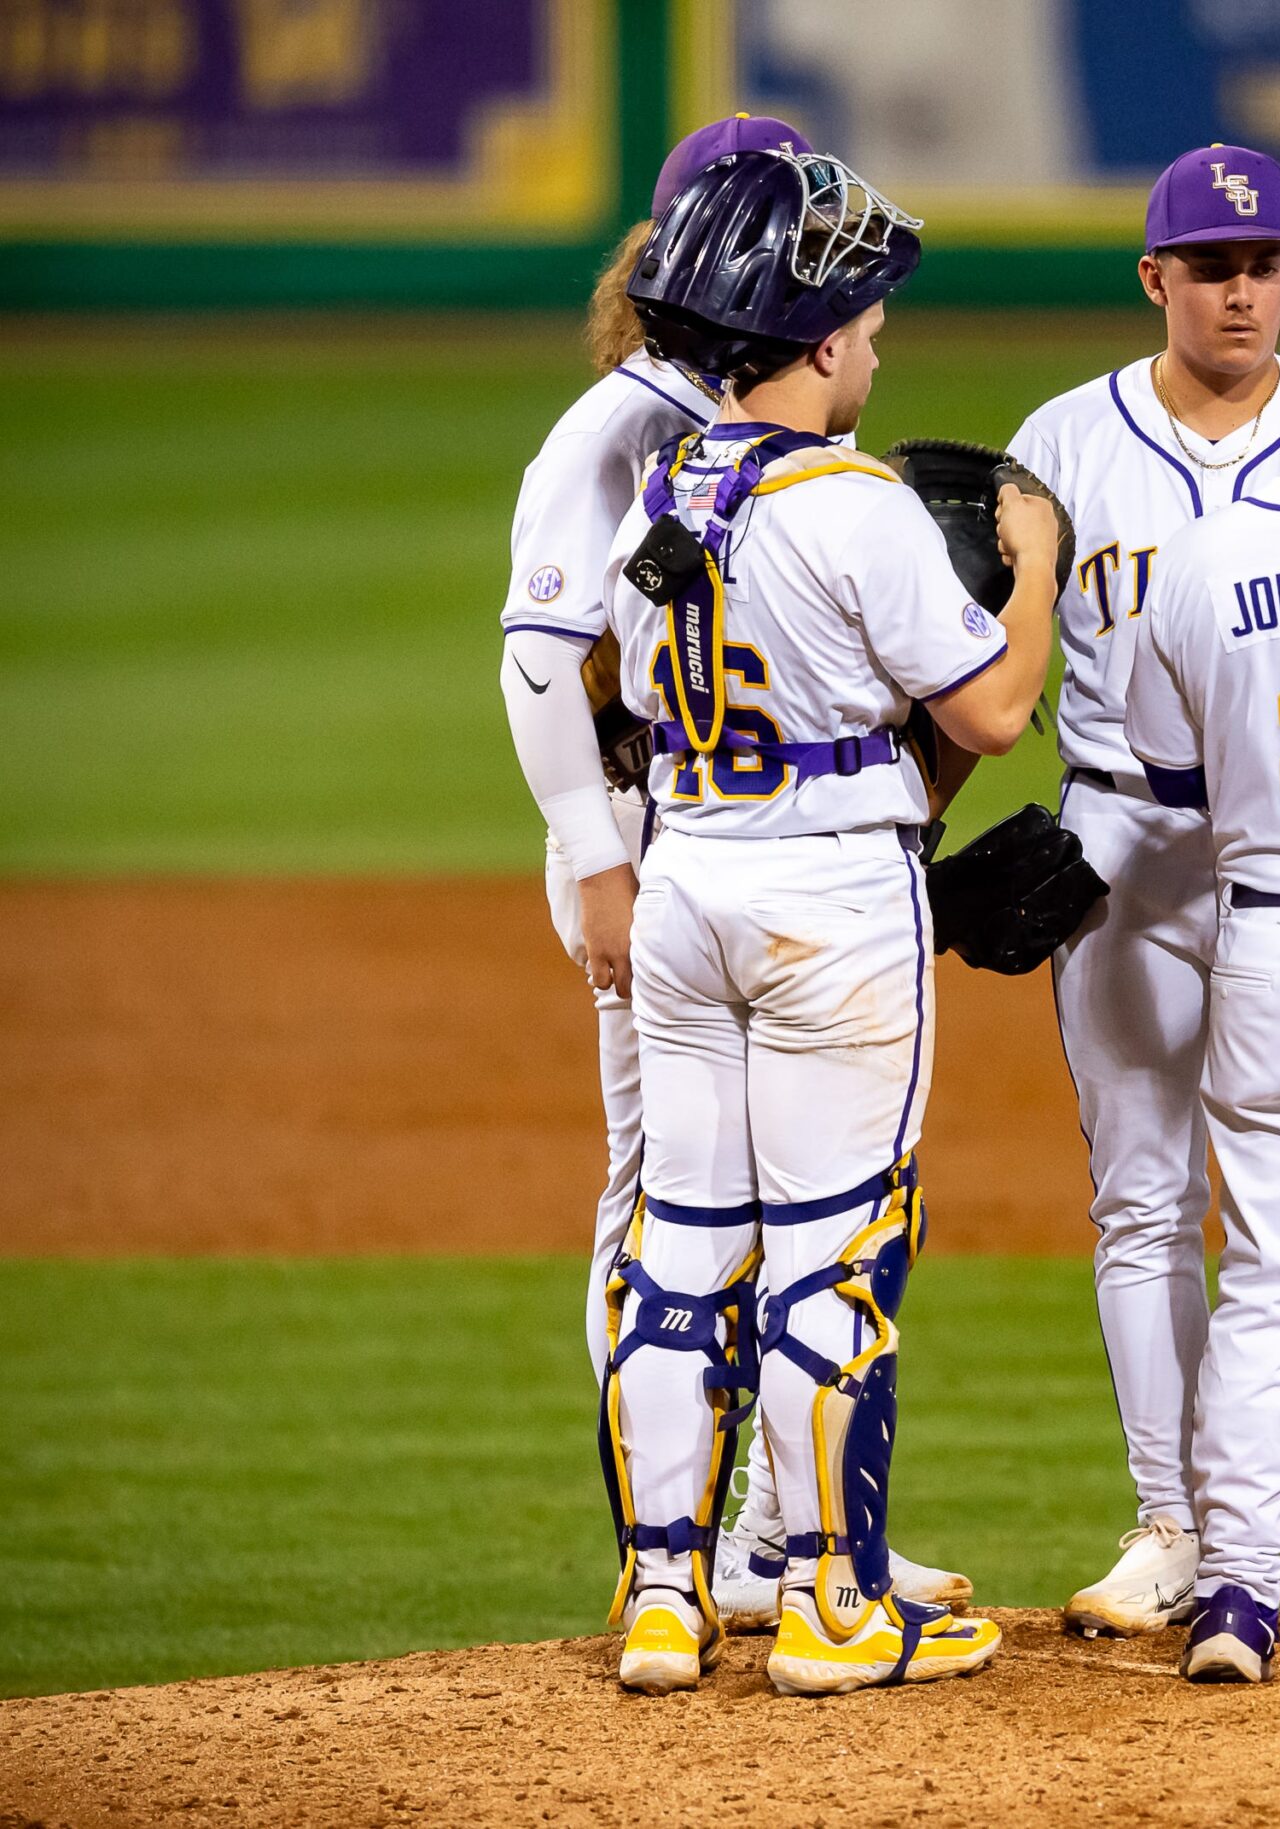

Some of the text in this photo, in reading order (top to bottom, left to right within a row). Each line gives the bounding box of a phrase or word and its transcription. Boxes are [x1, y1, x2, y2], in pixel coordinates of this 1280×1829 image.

[1211, 163, 1259, 216] LSU
[686, 602, 710, 694] marucci
[648, 640, 791, 801] 16
